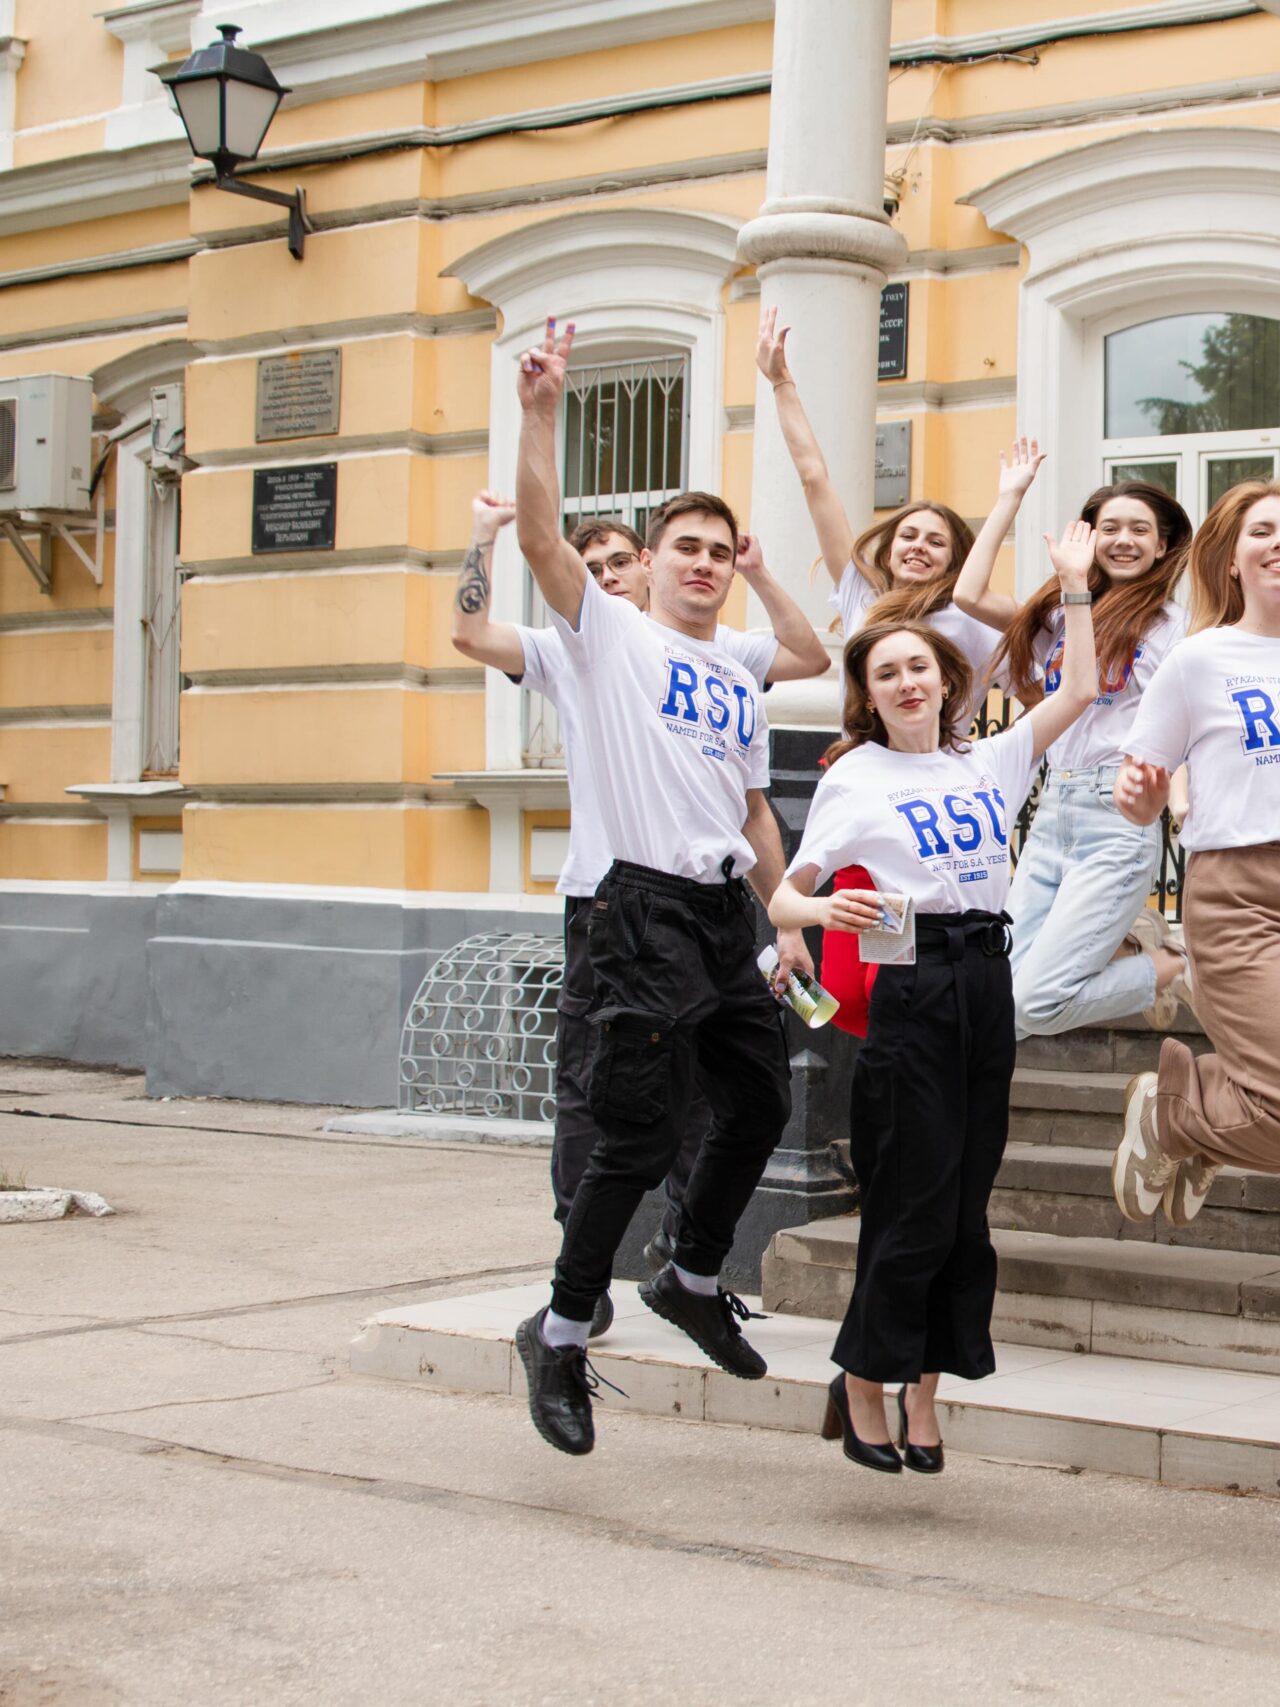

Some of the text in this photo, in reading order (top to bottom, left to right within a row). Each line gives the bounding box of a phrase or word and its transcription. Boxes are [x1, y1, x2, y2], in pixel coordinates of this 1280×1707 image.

[1225, 675, 1265, 688] RYAZAN
[658, 656, 756, 751] RSU
[666, 722, 698, 739] NAMED
[890, 783, 1007, 864] RSU
[953, 859, 969, 870] FOR
[973, 870, 988, 880] 1915
